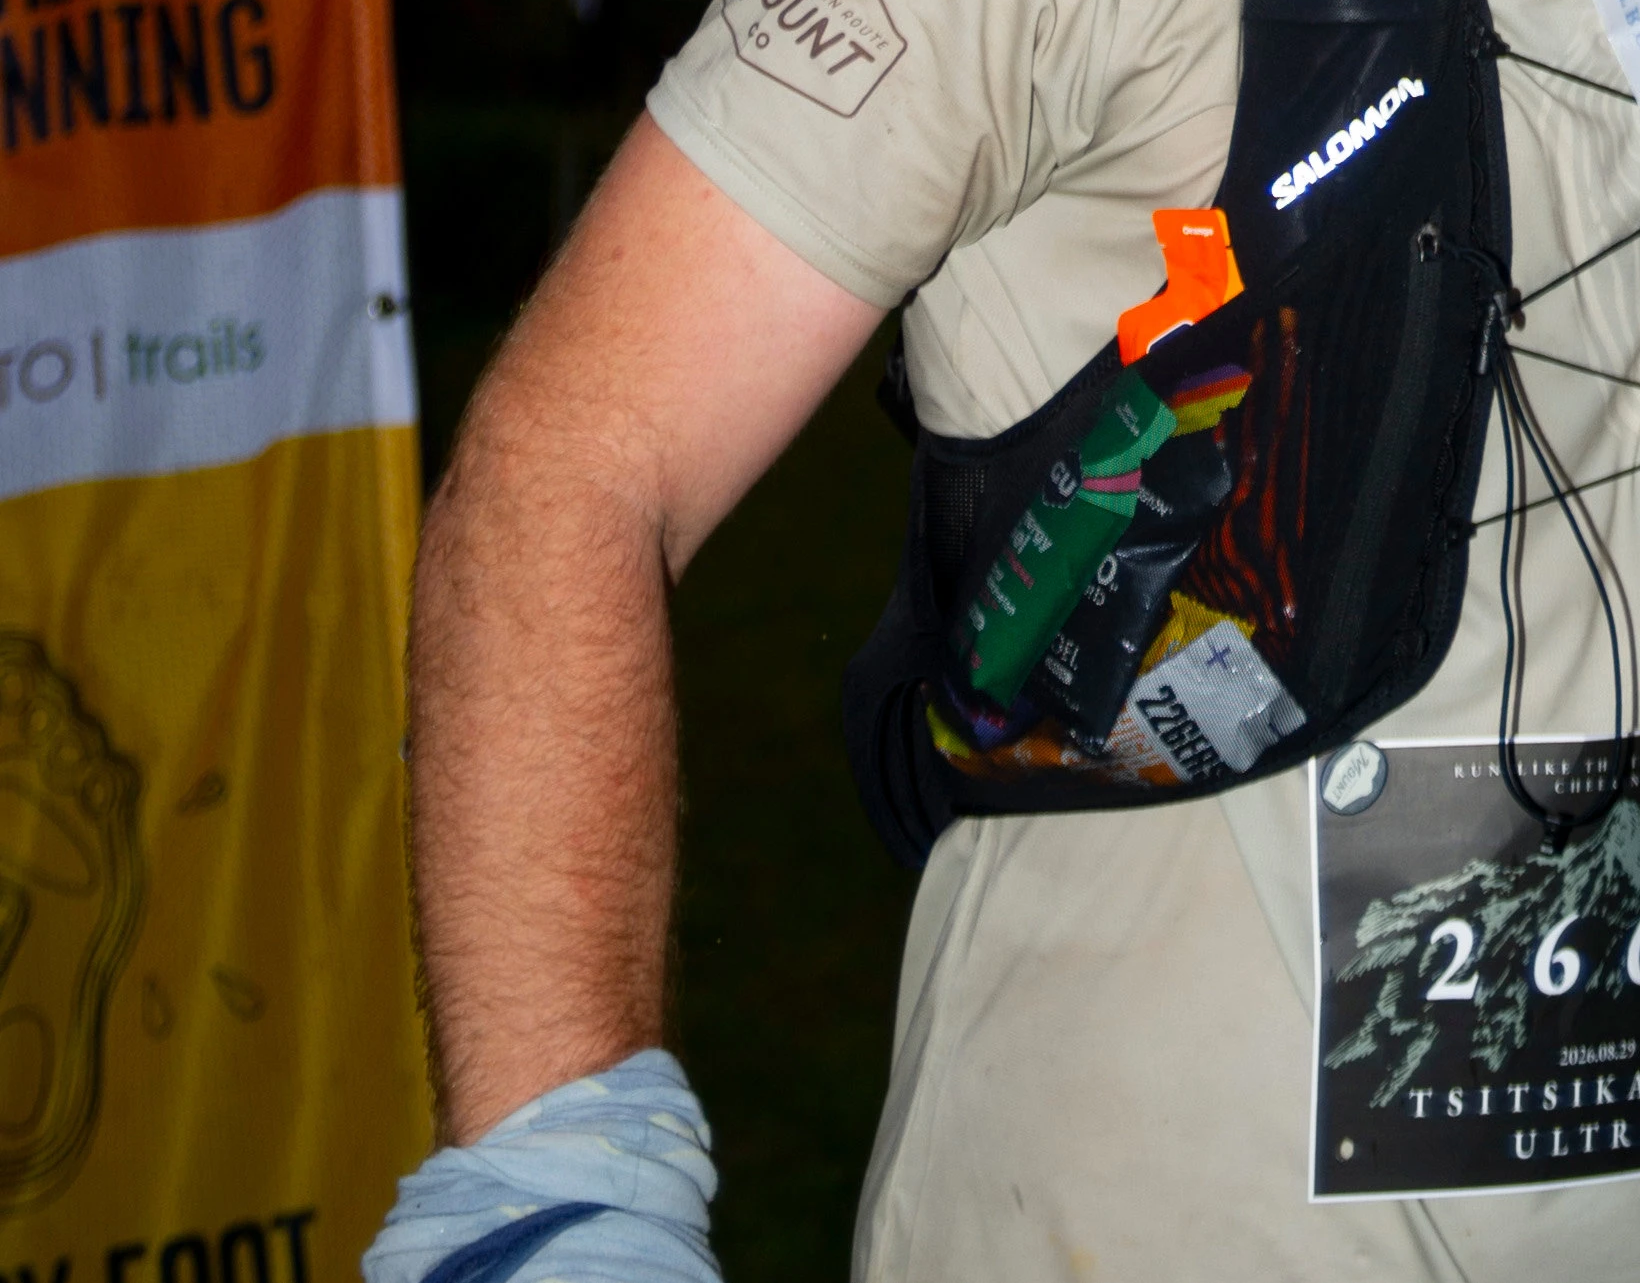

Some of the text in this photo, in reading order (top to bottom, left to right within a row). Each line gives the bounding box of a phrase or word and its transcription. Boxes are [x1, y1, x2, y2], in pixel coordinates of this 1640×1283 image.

[841, 9, 889, 51] ROUTE
[1270, 77, 1425, 210] SALOMON
[125, 315, 266, 386] trails
[1454, 763, 1501, 779] RUN
[1517, 758, 1570, 777] LIKE
[1559, 1039, 1638, 1068] 2026.08.29
